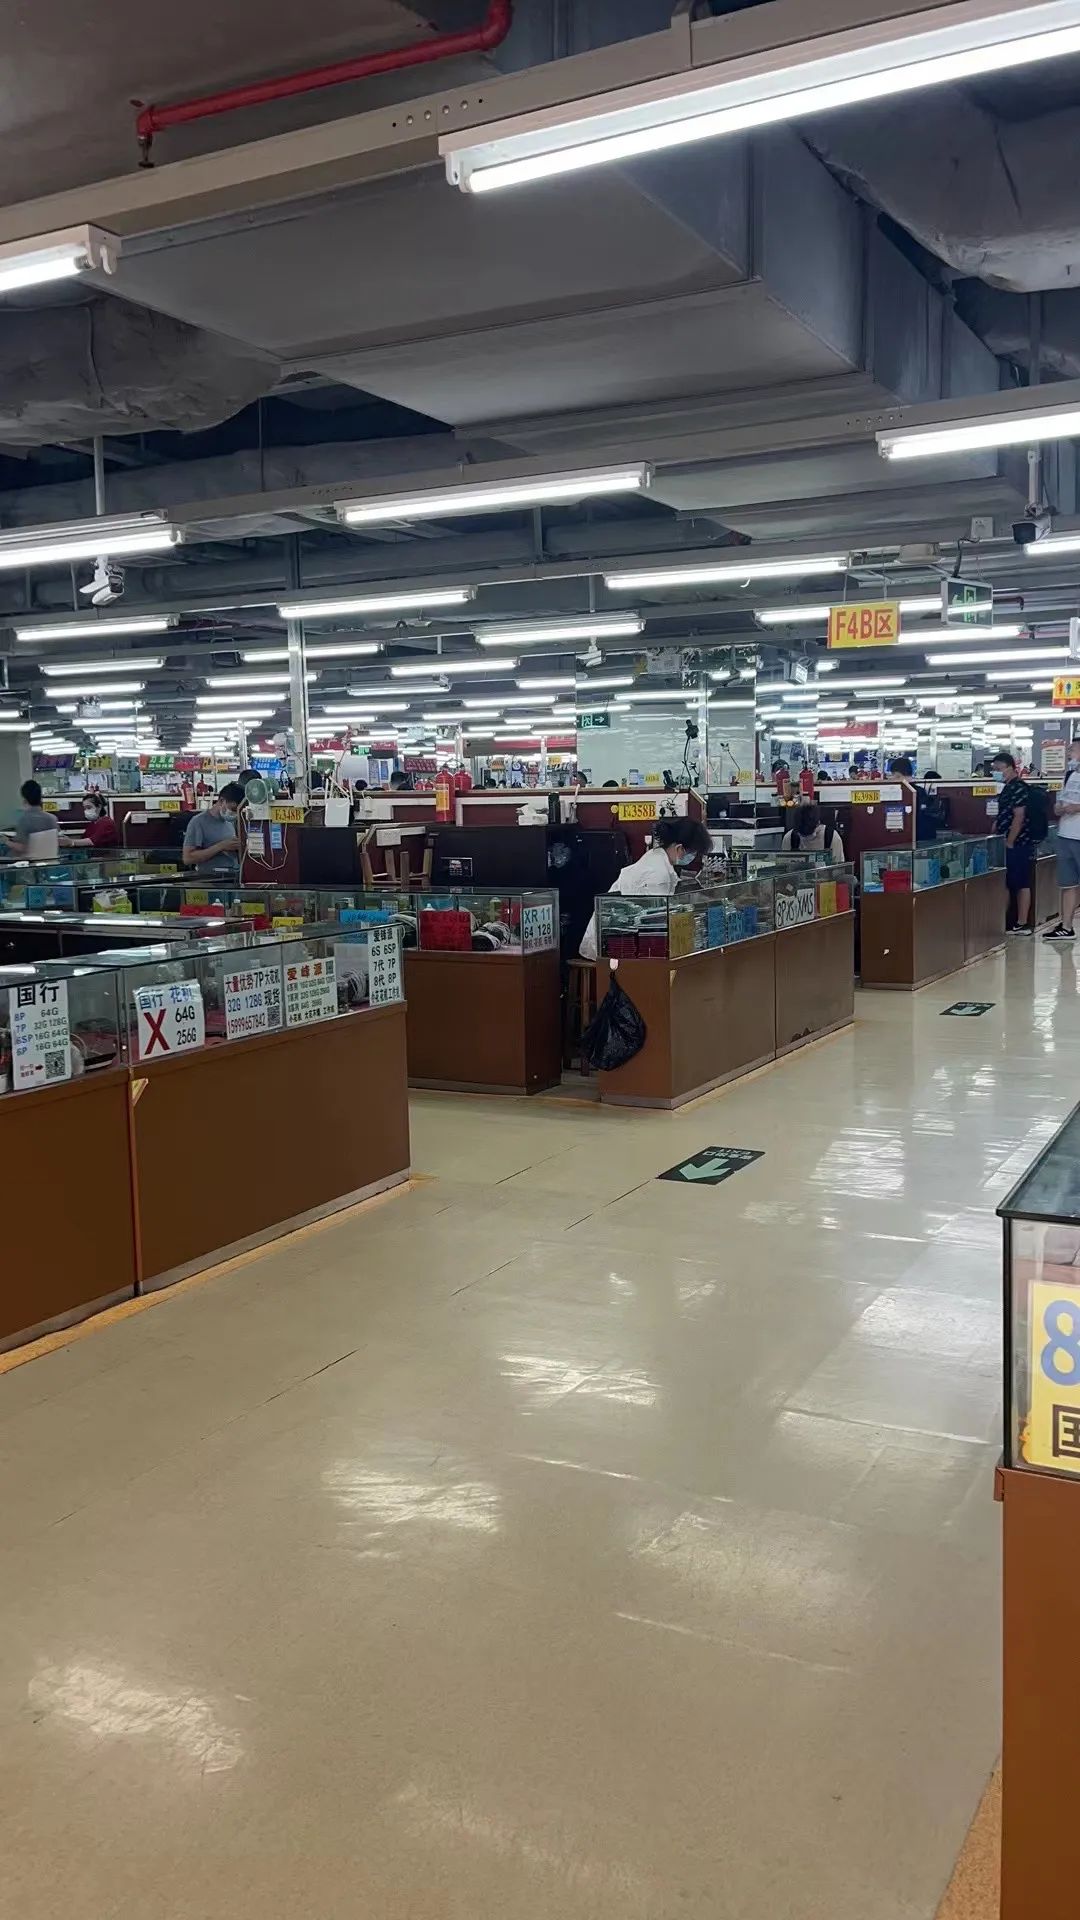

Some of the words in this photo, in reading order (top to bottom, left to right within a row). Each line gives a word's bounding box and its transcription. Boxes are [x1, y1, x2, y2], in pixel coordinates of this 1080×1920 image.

[836, 608, 893, 640] F4B区
[524, 909, 538, 923] XR
[541, 907, 551, 921] 11
[525, 926, 533, 939] 64
[538, 923, 551, 936] 128
[371, 945, 380, 957] 6S
[383, 943, 396, 955] 6SP
[373, 959, 385, 972] 7代
[388, 958, 396, 969] 7P
[373, 974, 385, 987] 8代
[388, 972, 396, 984] 8P
[17, 982, 60, 1008] 国行
[139, 993, 163, 1009] 国行
[227, 998, 241, 1013] 32G
[245, 993, 263, 1008] 128G
[264, 987, 280, 1006] 现货
[15, 1012, 25, 1021] 8P
[41, 1007, 59, 1017] 64G
[175, 1005, 196, 1023] 64G
[16, 1024, 27, 1032] 7P
[34, 1020, 47, 1030] 32G
[49, 1017, 67, 1027] 128G
[143, 1008, 170, 1055] X
[35, 1031, 50, 1041] 16G
[52, 1028, 68, 1037] 64G
[177, 1027, 197, 1046] 256G
[35, 1042, 51, 1051] 16G
[53, 1038, 69, 1048] 64G
